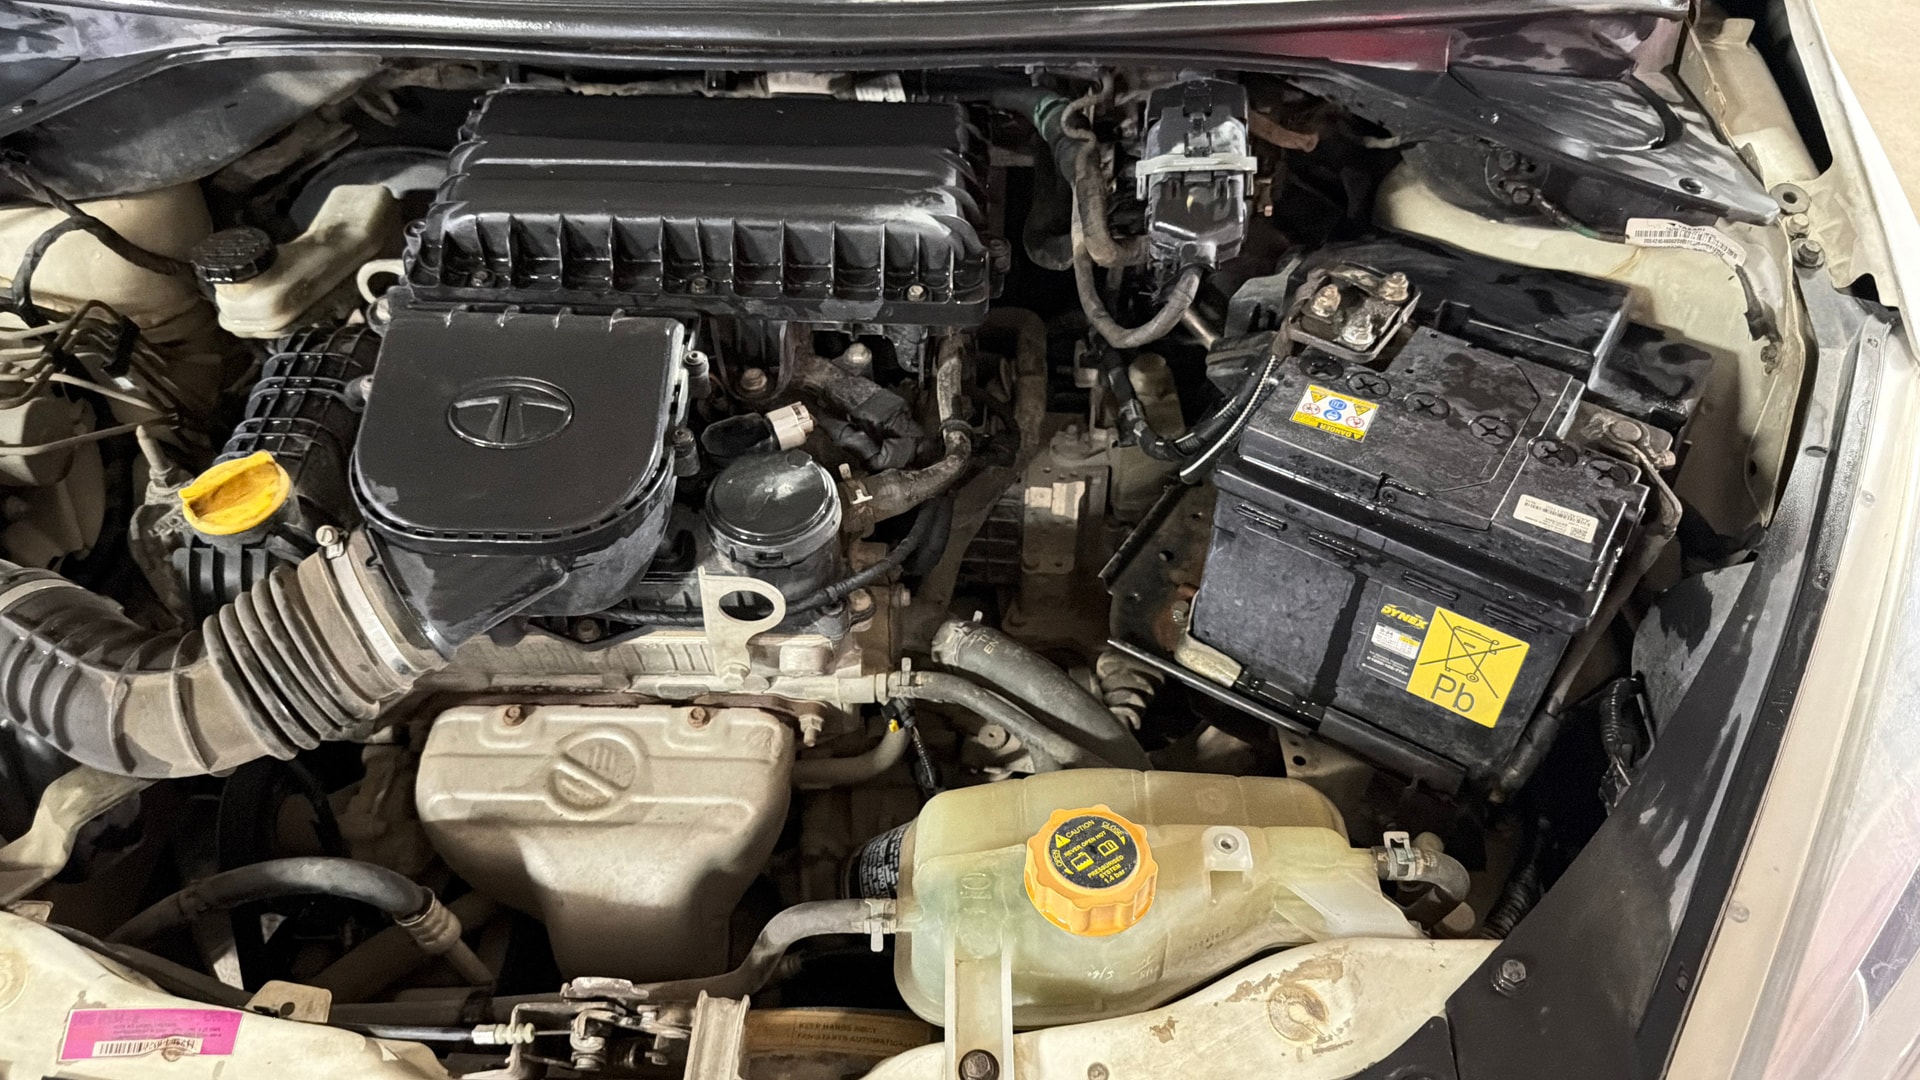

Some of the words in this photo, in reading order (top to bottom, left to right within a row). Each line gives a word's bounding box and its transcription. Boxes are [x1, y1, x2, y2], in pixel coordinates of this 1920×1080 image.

[1319, 423, 1352, 438] DANGER
[1381, 605, 1429, 630] DYNEX
[1431, 673, 1475, 713] Pb
[1065, 820, 1095, 839] CAUTION
[1102, 821, 1124, 837] CLOSE
[1064, 844, 1083, 857] NEVER
[1081, 836, 1097, 847] OPEN
[1095, 831, 1107, 840] HOT
[1052, 850, 1063, 867] OPEN
[1088, 855, 1124, 879] PRESSURISED
[1099, 863, 1121, 879] SYSTEM
[1114, 869, 1125, 879] bar
